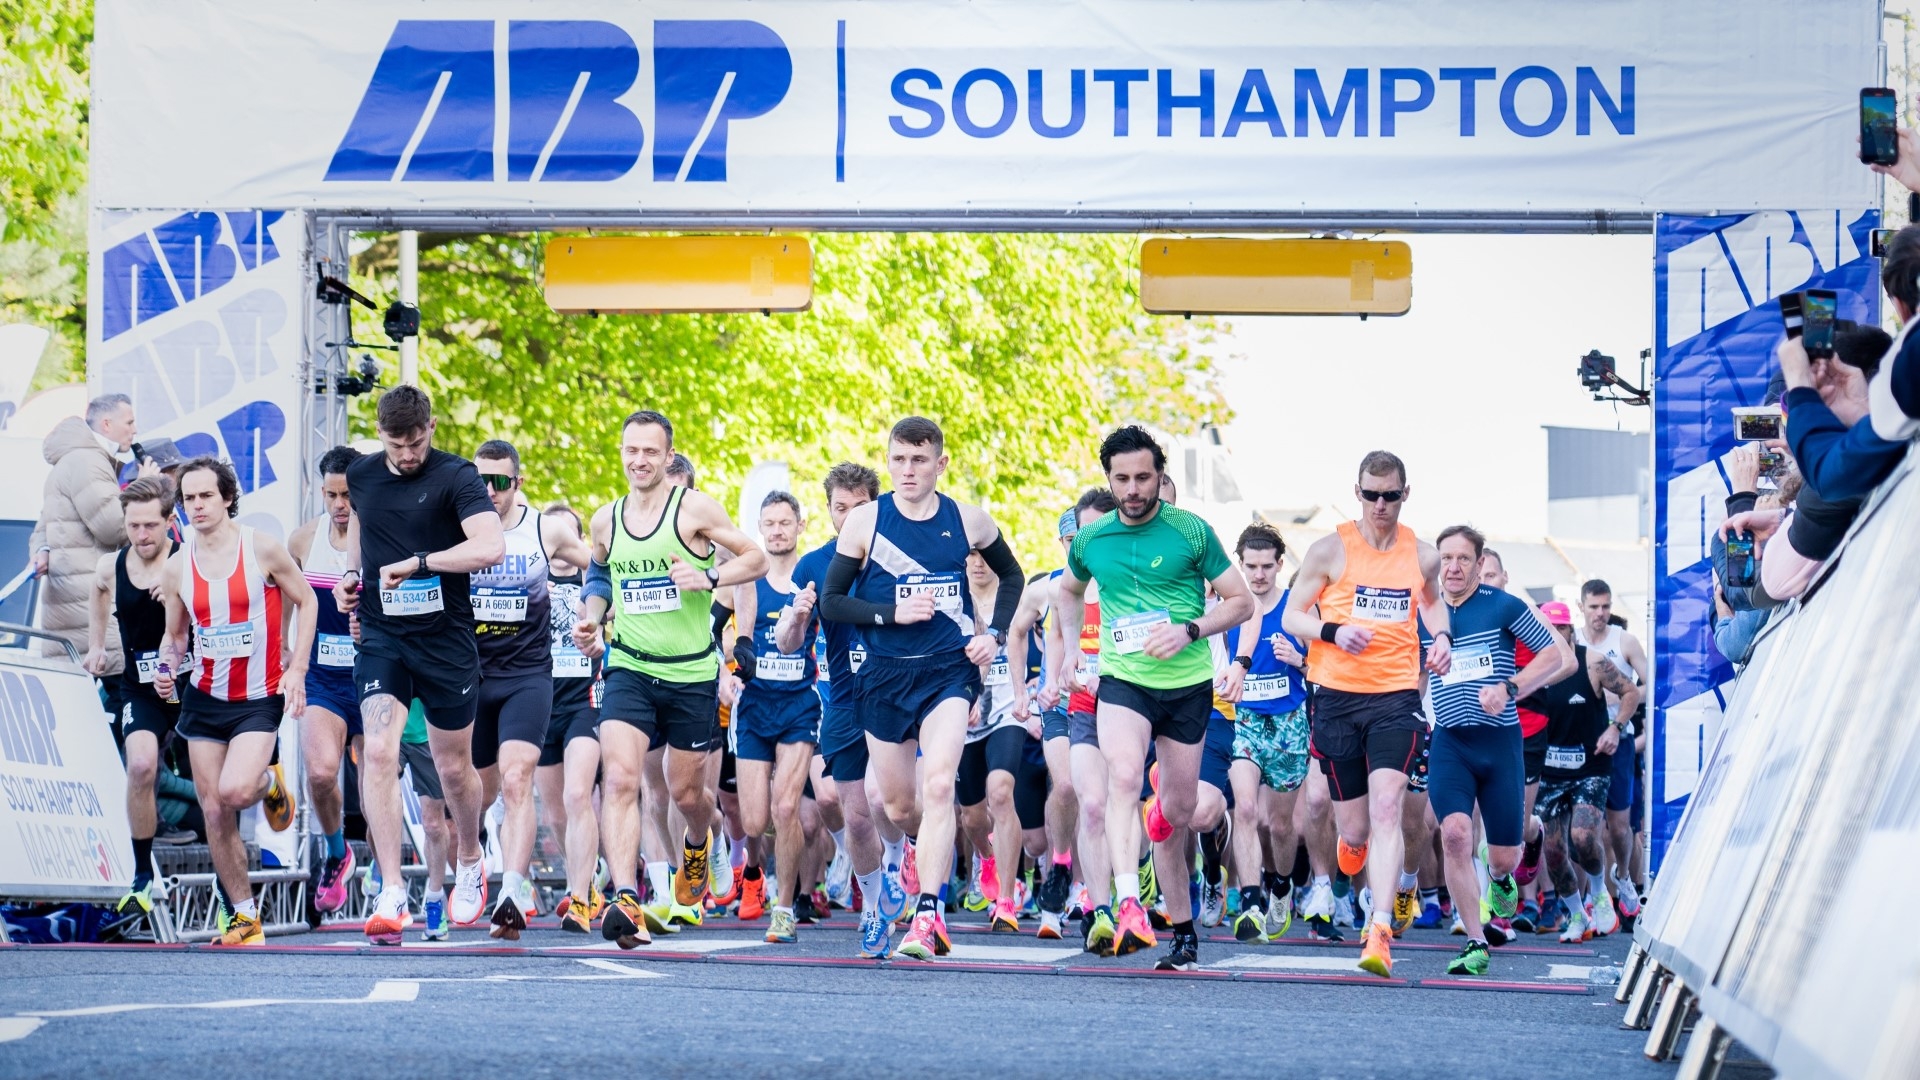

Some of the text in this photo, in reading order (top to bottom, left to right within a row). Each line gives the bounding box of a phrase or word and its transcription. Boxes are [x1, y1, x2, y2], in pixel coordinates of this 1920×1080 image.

[323, 20, 1637, 182] ABP SOUTHAMPTON
[394, 592, 426, 603] A 5342
[636, 590, 661, 602] A 6407
[485, 599, 512, 610] A 6690
[1371, 599, 1397, 610] A 6274
[1132, 626, 1151, 639] 533
[210, 637, 241, 648] A 5115
[331, 647, 356, 656] A 534
[771, 662, 776, 670] A
[1459, 659, 1479, 671] 3268
[1253, 682, 1275, 691] A 7161
[0, 773, 104, 818] SOUTHAMPTON
